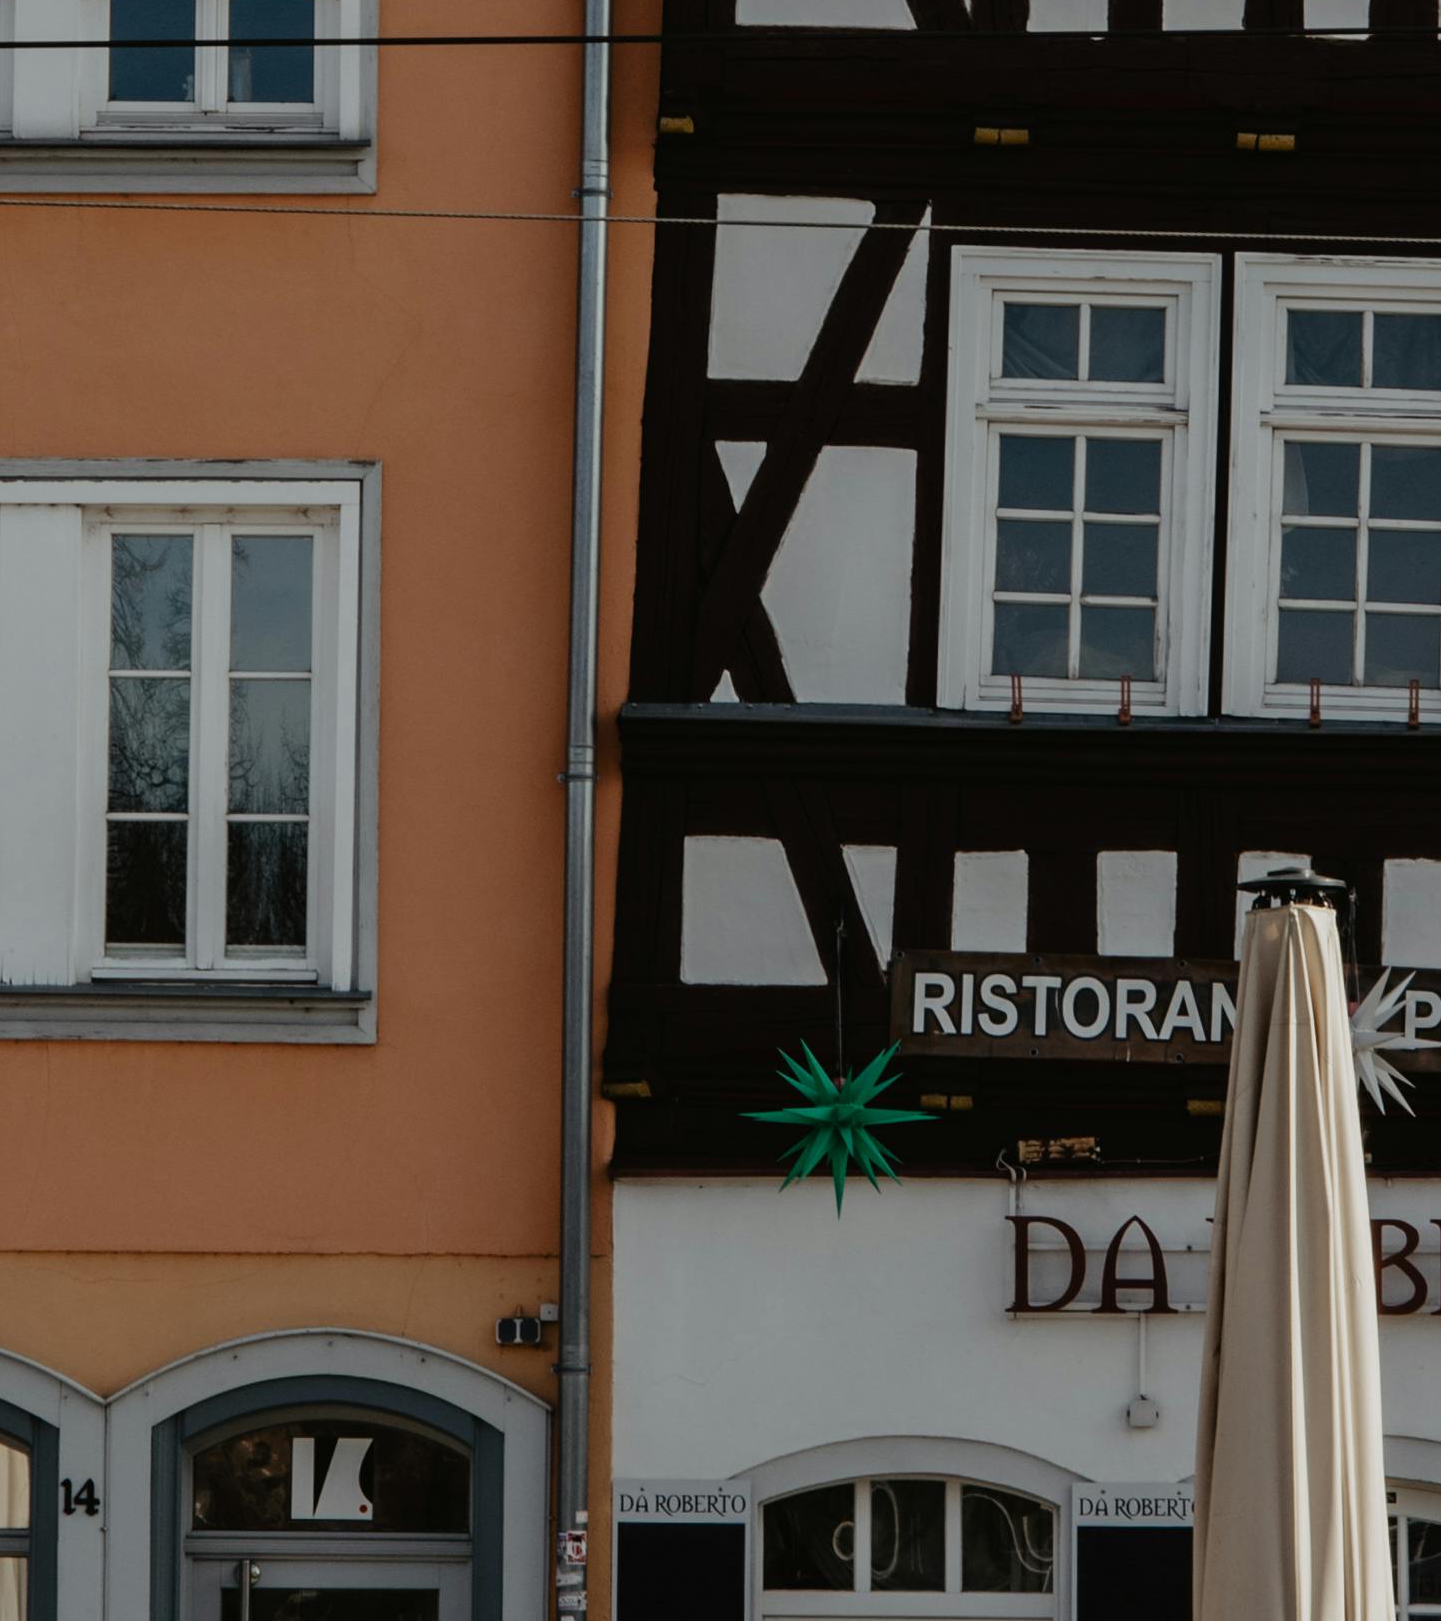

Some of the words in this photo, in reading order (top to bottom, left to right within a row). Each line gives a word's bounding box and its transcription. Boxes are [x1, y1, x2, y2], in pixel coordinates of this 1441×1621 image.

[912, 972, 1236, 1042] RISTORAN
[1005, 1215, 1179, 1313] DA
[61, 1479, 100, 1515] 14
[620, 1494, 649, 1513] DA
[655, 1494, 746, 1516] ROBERTO
[1080, 1498, 1108, 1516] DA
[1115, 1498, 1195, 1520] ROBERT
